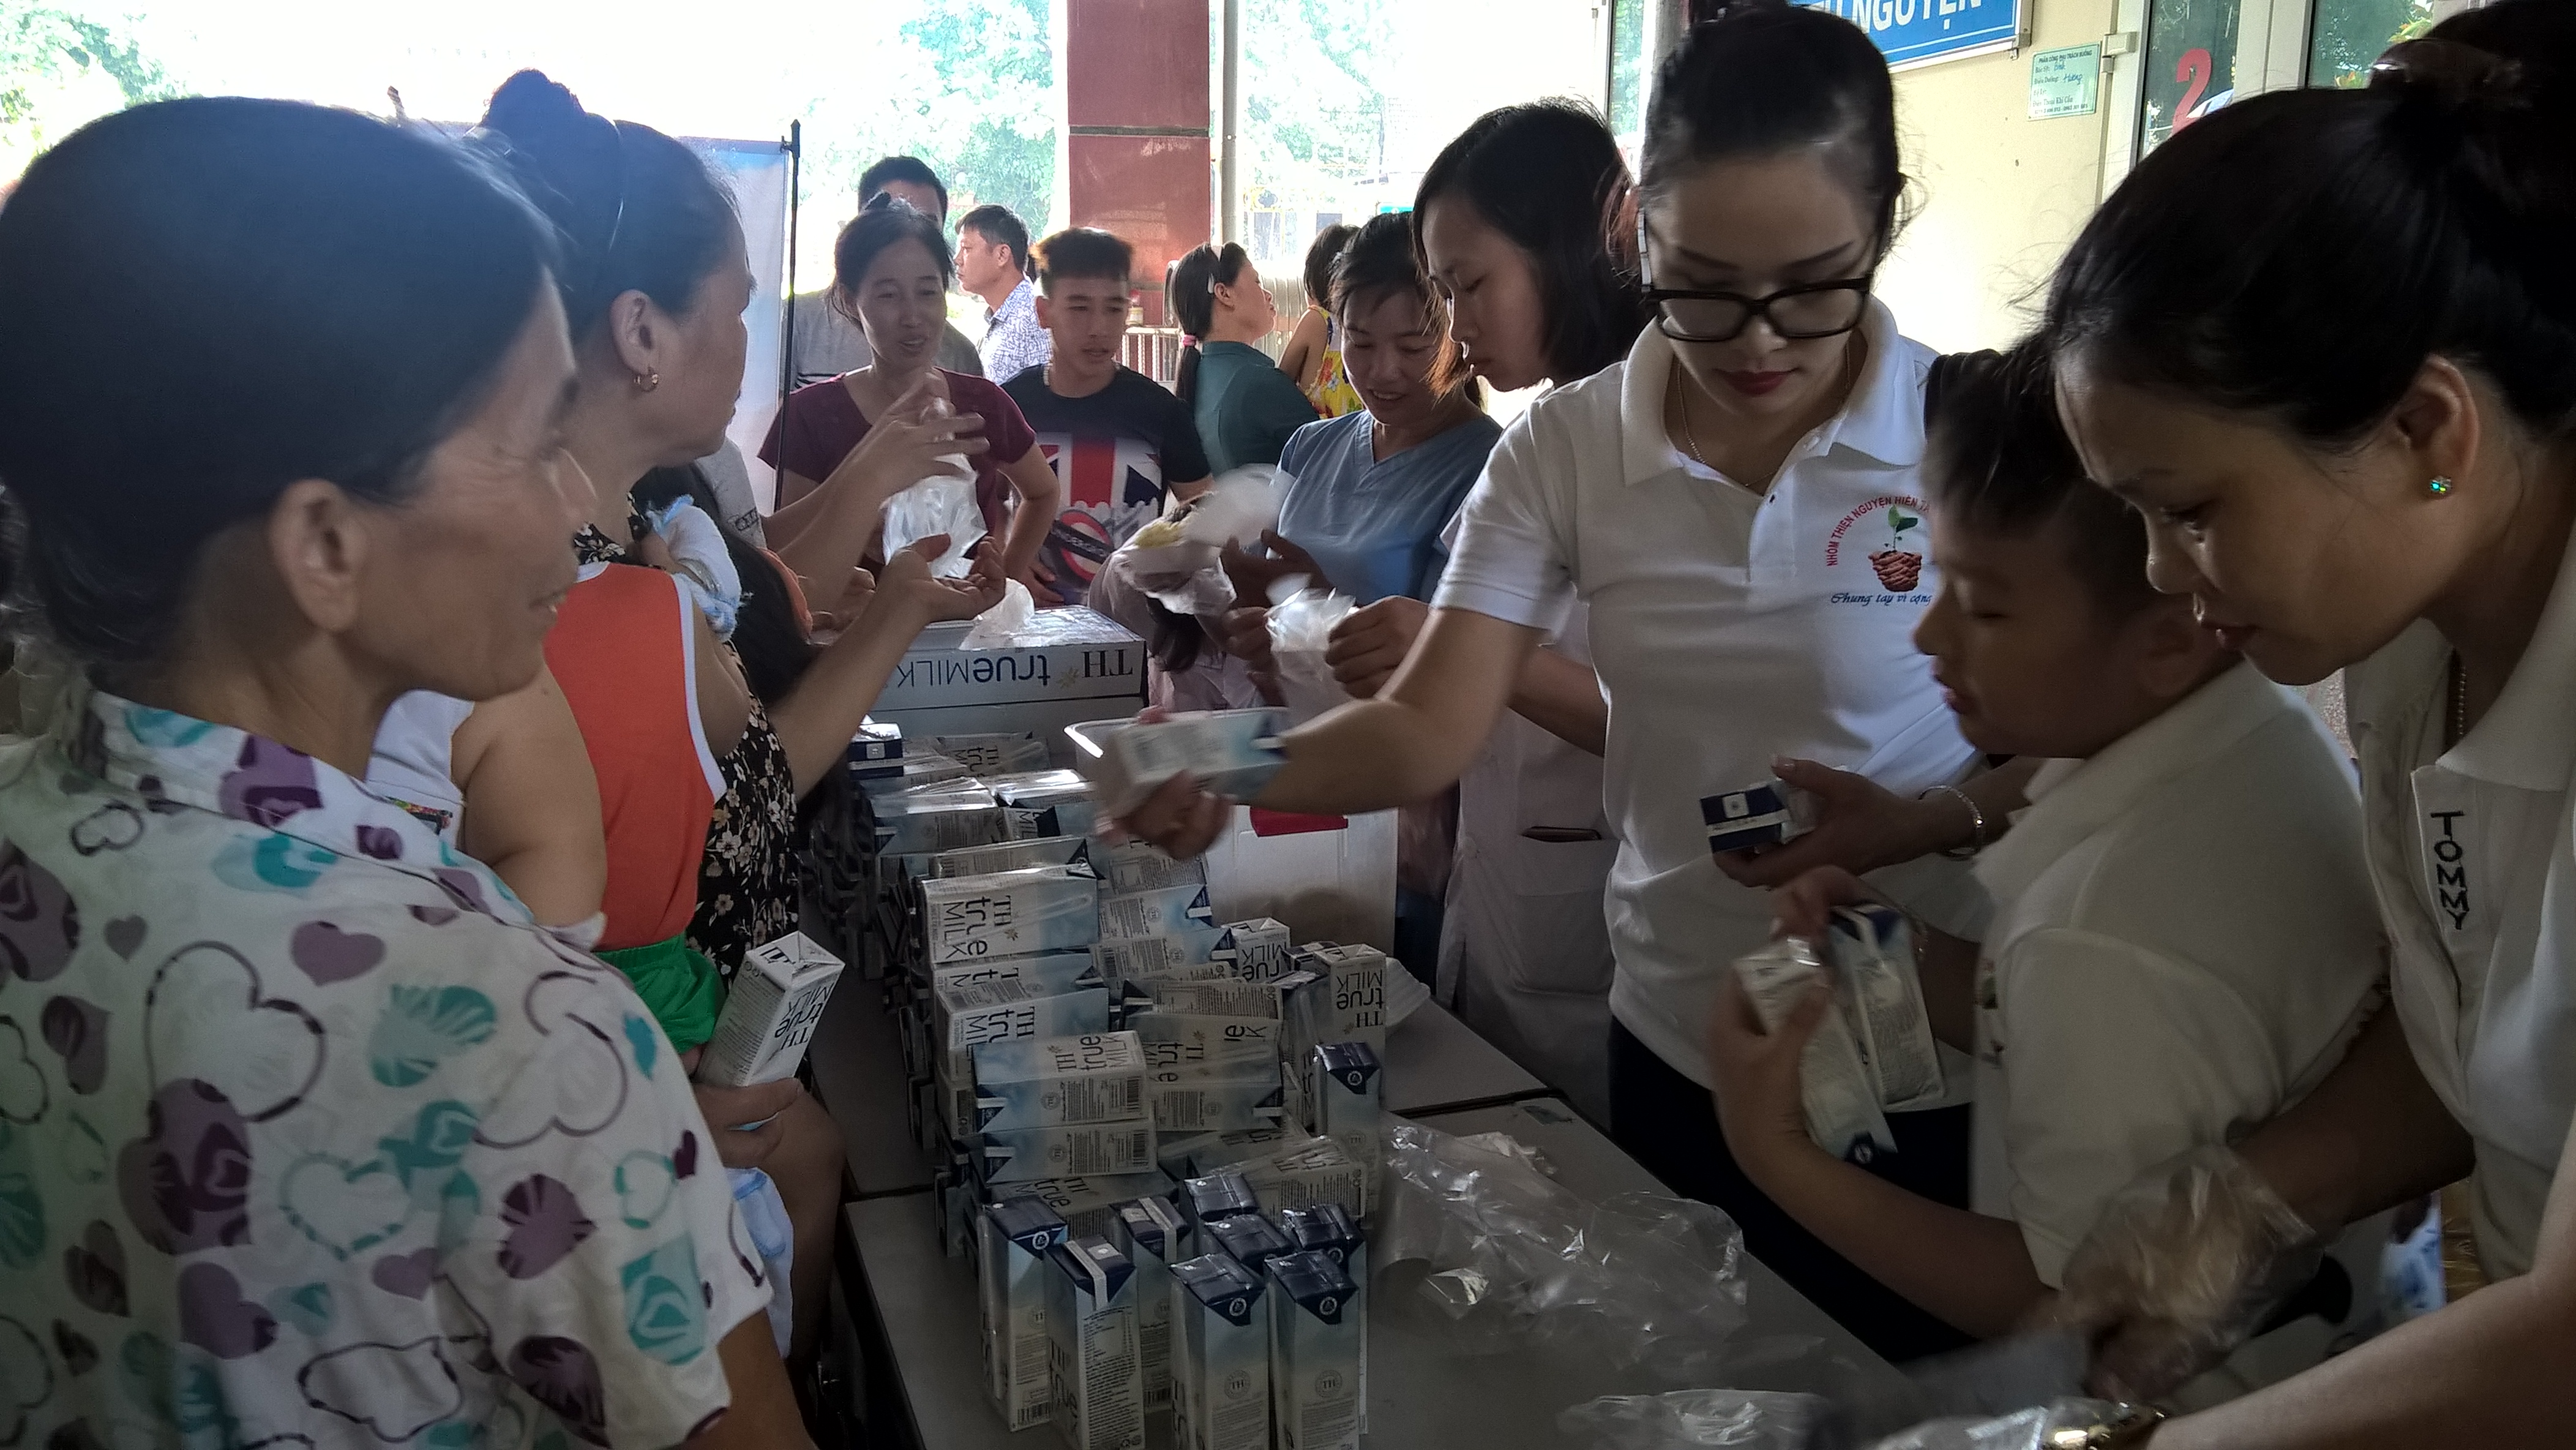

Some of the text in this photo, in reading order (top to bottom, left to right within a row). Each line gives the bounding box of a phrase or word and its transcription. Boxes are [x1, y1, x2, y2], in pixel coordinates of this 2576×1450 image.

[1851, 0, 1981, 34] NGU
[2171, 48, 2212, 135] 2
[1831, 593, 1873, 606] Chung
[1876, 594, 1895, 606] tay
[1082, 648, 1133, 678] TH
[2430, 811, 2469, 930] TOMMY
[994, 895, 1012, 927] TH
[943, 901, 967, 959] MILK
[1242, 960, 1280, 980] rue
[1336, 969, 1383, 993] MILK
[782, 982, 834, 1020] MILK
[1336, 988, 1384, 1010] true
[774, 1002, 823, 1039] true
[989, 1010, 1015, 1042] tru
[1016, 1006, 1035, 1039] TH
[1356, 1011, 1383, 1028] TH
[781, 1027, 809, 1050] TH
[965, 1015, 988, 1057] MIL
[1055, 1054, 1077, 1072] TH
[1079, 1035, 1107, 1071] true
